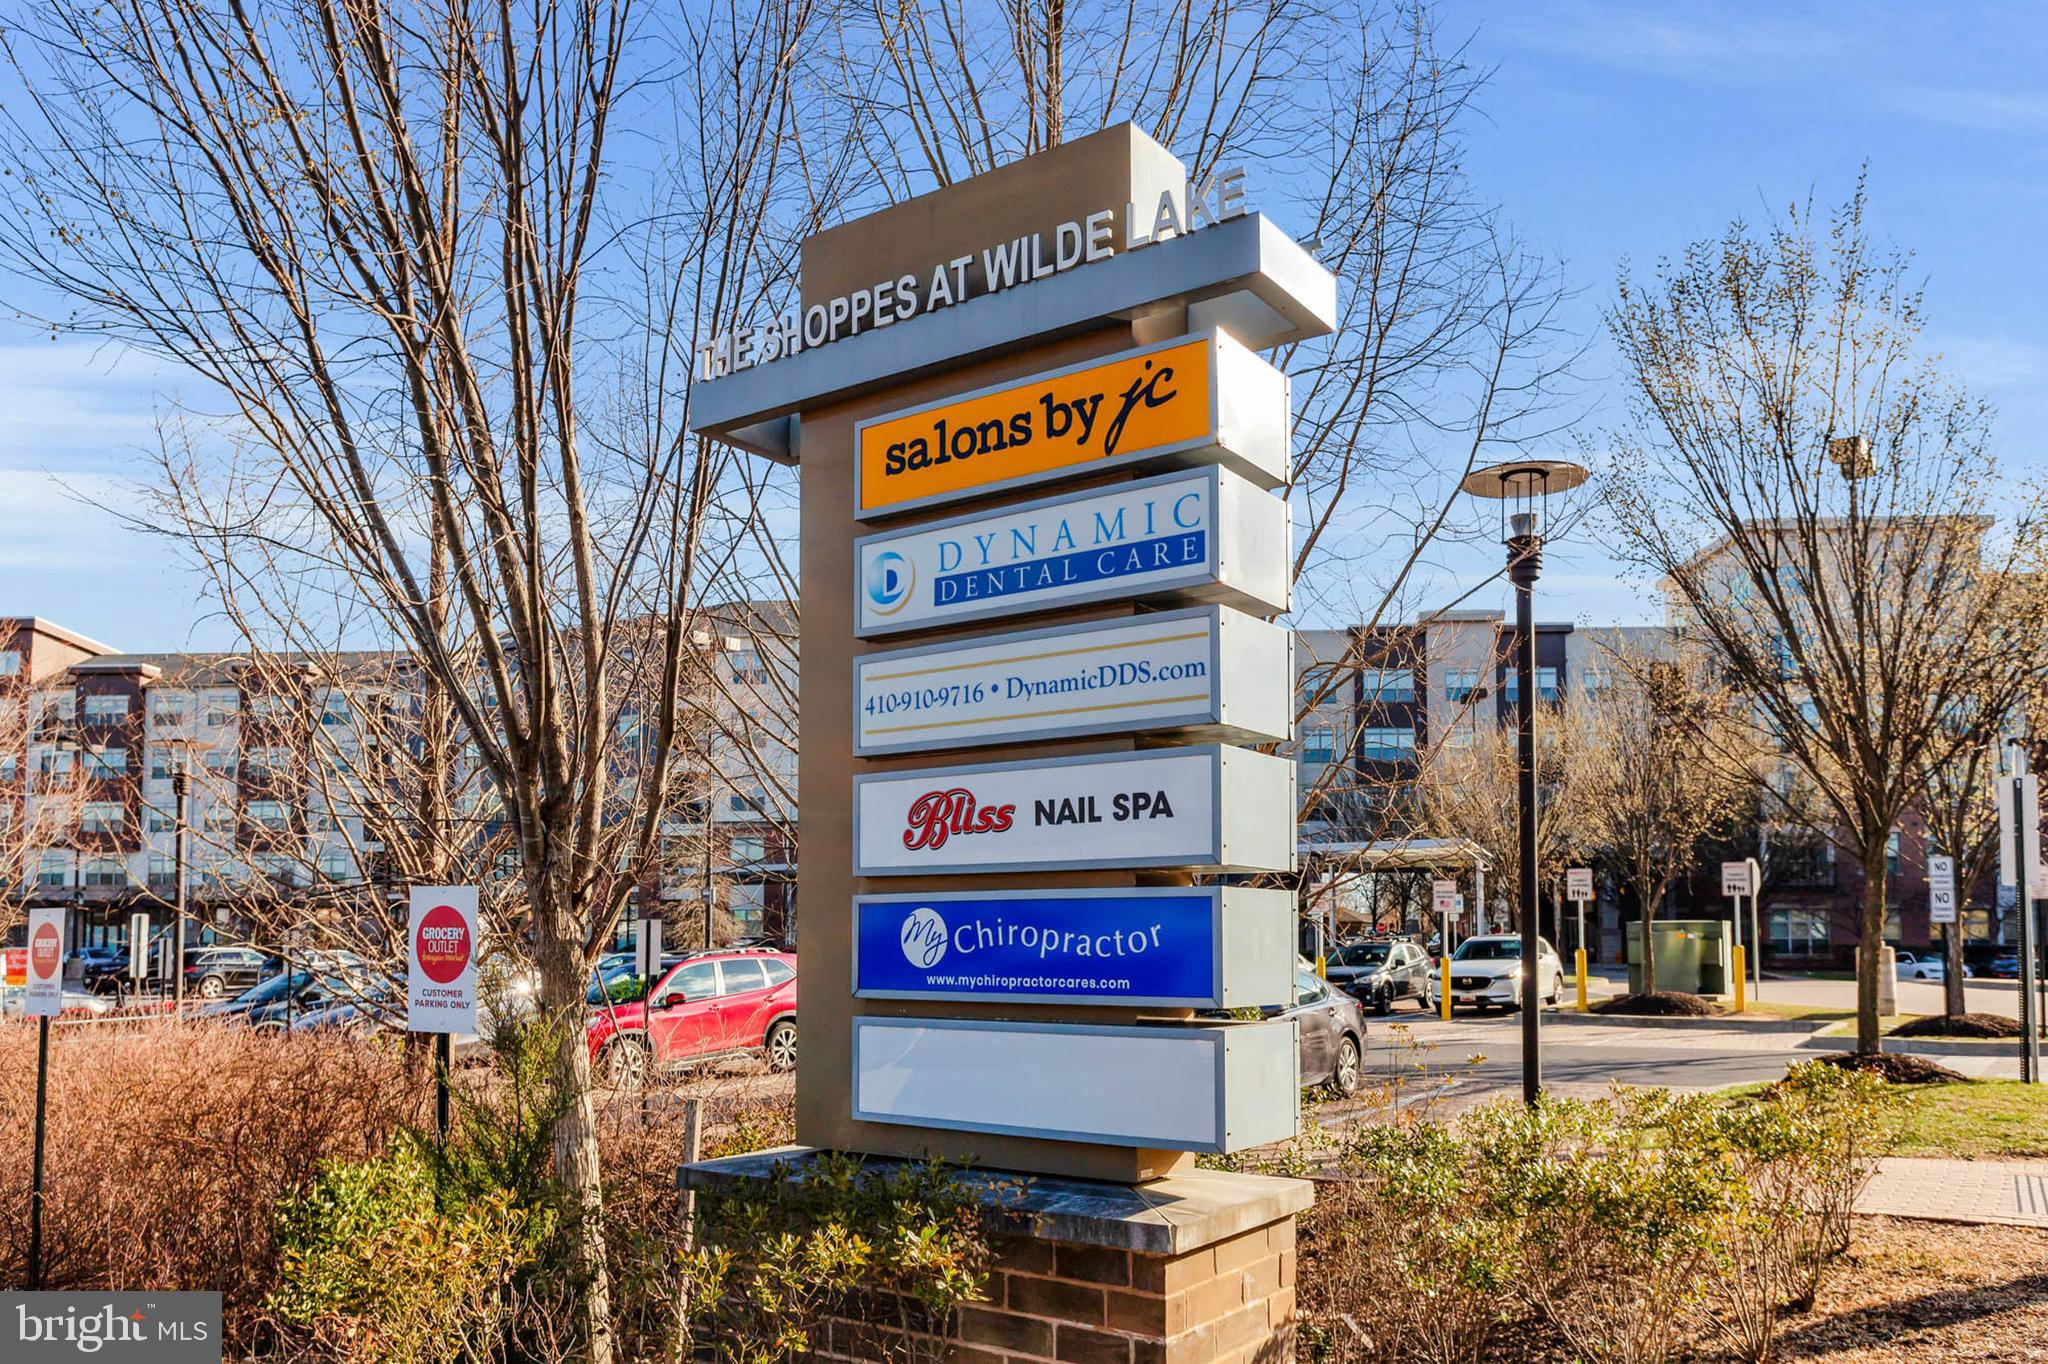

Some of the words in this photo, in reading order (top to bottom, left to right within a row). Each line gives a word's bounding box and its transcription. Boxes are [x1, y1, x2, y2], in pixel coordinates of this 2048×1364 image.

[696, 327, 755, 381] THE
[763, 274, 919, 362] SHOPPES
[926, 254, 973, 312] AT
[983, 209, 1113, 292] WILDE
[1126, 166, 1246, 250] LAKE
[885, 411, 1033, 477] salons
[1045, 393, 1103, 445] by
[1104, 360, 1177, 456] jc
[938, 493, 1201, 573] DYNAMIC
[940, 557, 1077, 602] DENTAL
[1097, 536, 1200, 575] CARE
[865, 681, 984, 716] 410-910-9716
[1006, 660, 1206, 702] DynamicDDS.com
[902, 786, 1016, 851] Bliss
[1034, 796, 1101, 826] NAIL
[1112, 790, 1174, 822] SPA
[1934, 861, 1948, 872] NO
[1935, 892, 1950, 904] NO
[422, 927, 466, 940] GROCERY
[428, 940, 459, 954] OUTLET
[904, 912, 948, 968] My
[954, 917, 1162, 959] Chiropractor
[422, 988, 463, 999] CUSTOMER
[926, 972, 1131, 990] www.mychiropractorcares.com
[415, 999, 448, 1009] PARKING
[450, 1000, 471, 1010] ONLY
